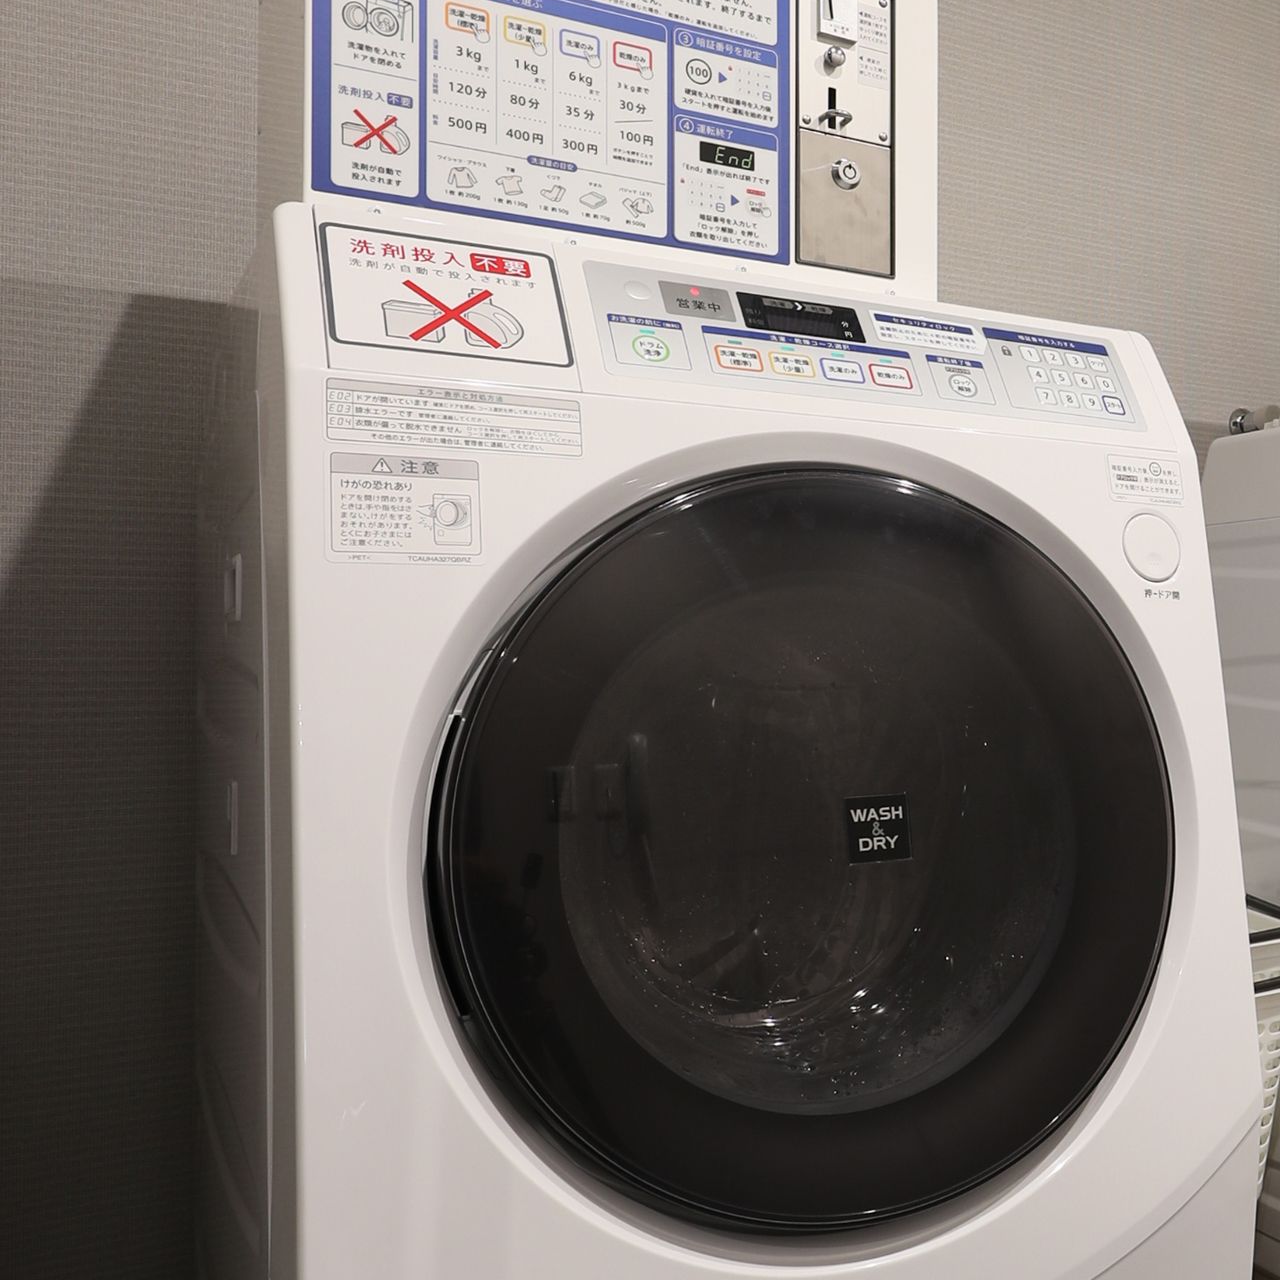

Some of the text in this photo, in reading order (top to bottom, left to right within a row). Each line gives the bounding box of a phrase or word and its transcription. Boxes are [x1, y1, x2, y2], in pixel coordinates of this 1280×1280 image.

[347, 41, 406, 59] 洗濯物を入れて
[565, 40, 594, 53] 洗濯のみ
[696, 37, 762, 61] 暗証番号を設定
[353, 53, 402, 69] ドアを閉める
[455, 46, 481, 63] 3kg
[618, 52, 646, 64] 乾燥のみ
[514, 59, 539, 75] 1kg
[689, 65, 709, 78] 100
[568, 71, 593, 87] 6kg
[338, 85, 411, 107] 洗剤投入 不要
[448, 82, 487, 100] 120分
[509, 94, 540, 110] 80分
[619, 100, 646, 115] 30分
[565, 106, 595, 121] 35分
[447, 117, 487, 135] 500円
[696, 124, 733, 139] 運転終了
[505, 129, 544, 145] 400円
[619, 131, 654, 146] 100円
[562, 139, 598, 155] 300円
[715, 147, 753, 170] End
[351, 162, 402, 177] 洗剤が自動で
[351, 172, 402, 187] 投入されます
[699, 214, 758, 230] 暗証番号を入力して
[689, 231, 768, 249] 衣類を取り出してください
[350, 238, 527, 276] 洗剤投入 不要
[348, 257, 537, 289] 洗剤が自動で投入されます
[675, 298, 721, 313] 営業中
[892, 318, 956, 332] セキュリティロック
[638, 341, 664, 350] ドラム
[1017, 335, 1075, 349] 暗証番号を入力する
[876, 371, 905, 380] 乾燥のみ
[355, 394, 429, 407] ドアが開いています
[417, 389, 503, 403] エラー表示と対処方法
[355, 406, 413, 417] 排水エラーです
[400, 460, 440, 475] 注意
[340, 479, 413, 492] けがの恐れあり
[340, 494, 412, 504] ドアを開け閉めする
[340, 530, 412, 538] とくにお子さまには
[850, 805, 903, 823] WASH
[871, 821, 885, 836] &
[858, 835, 899, 852] DRY
